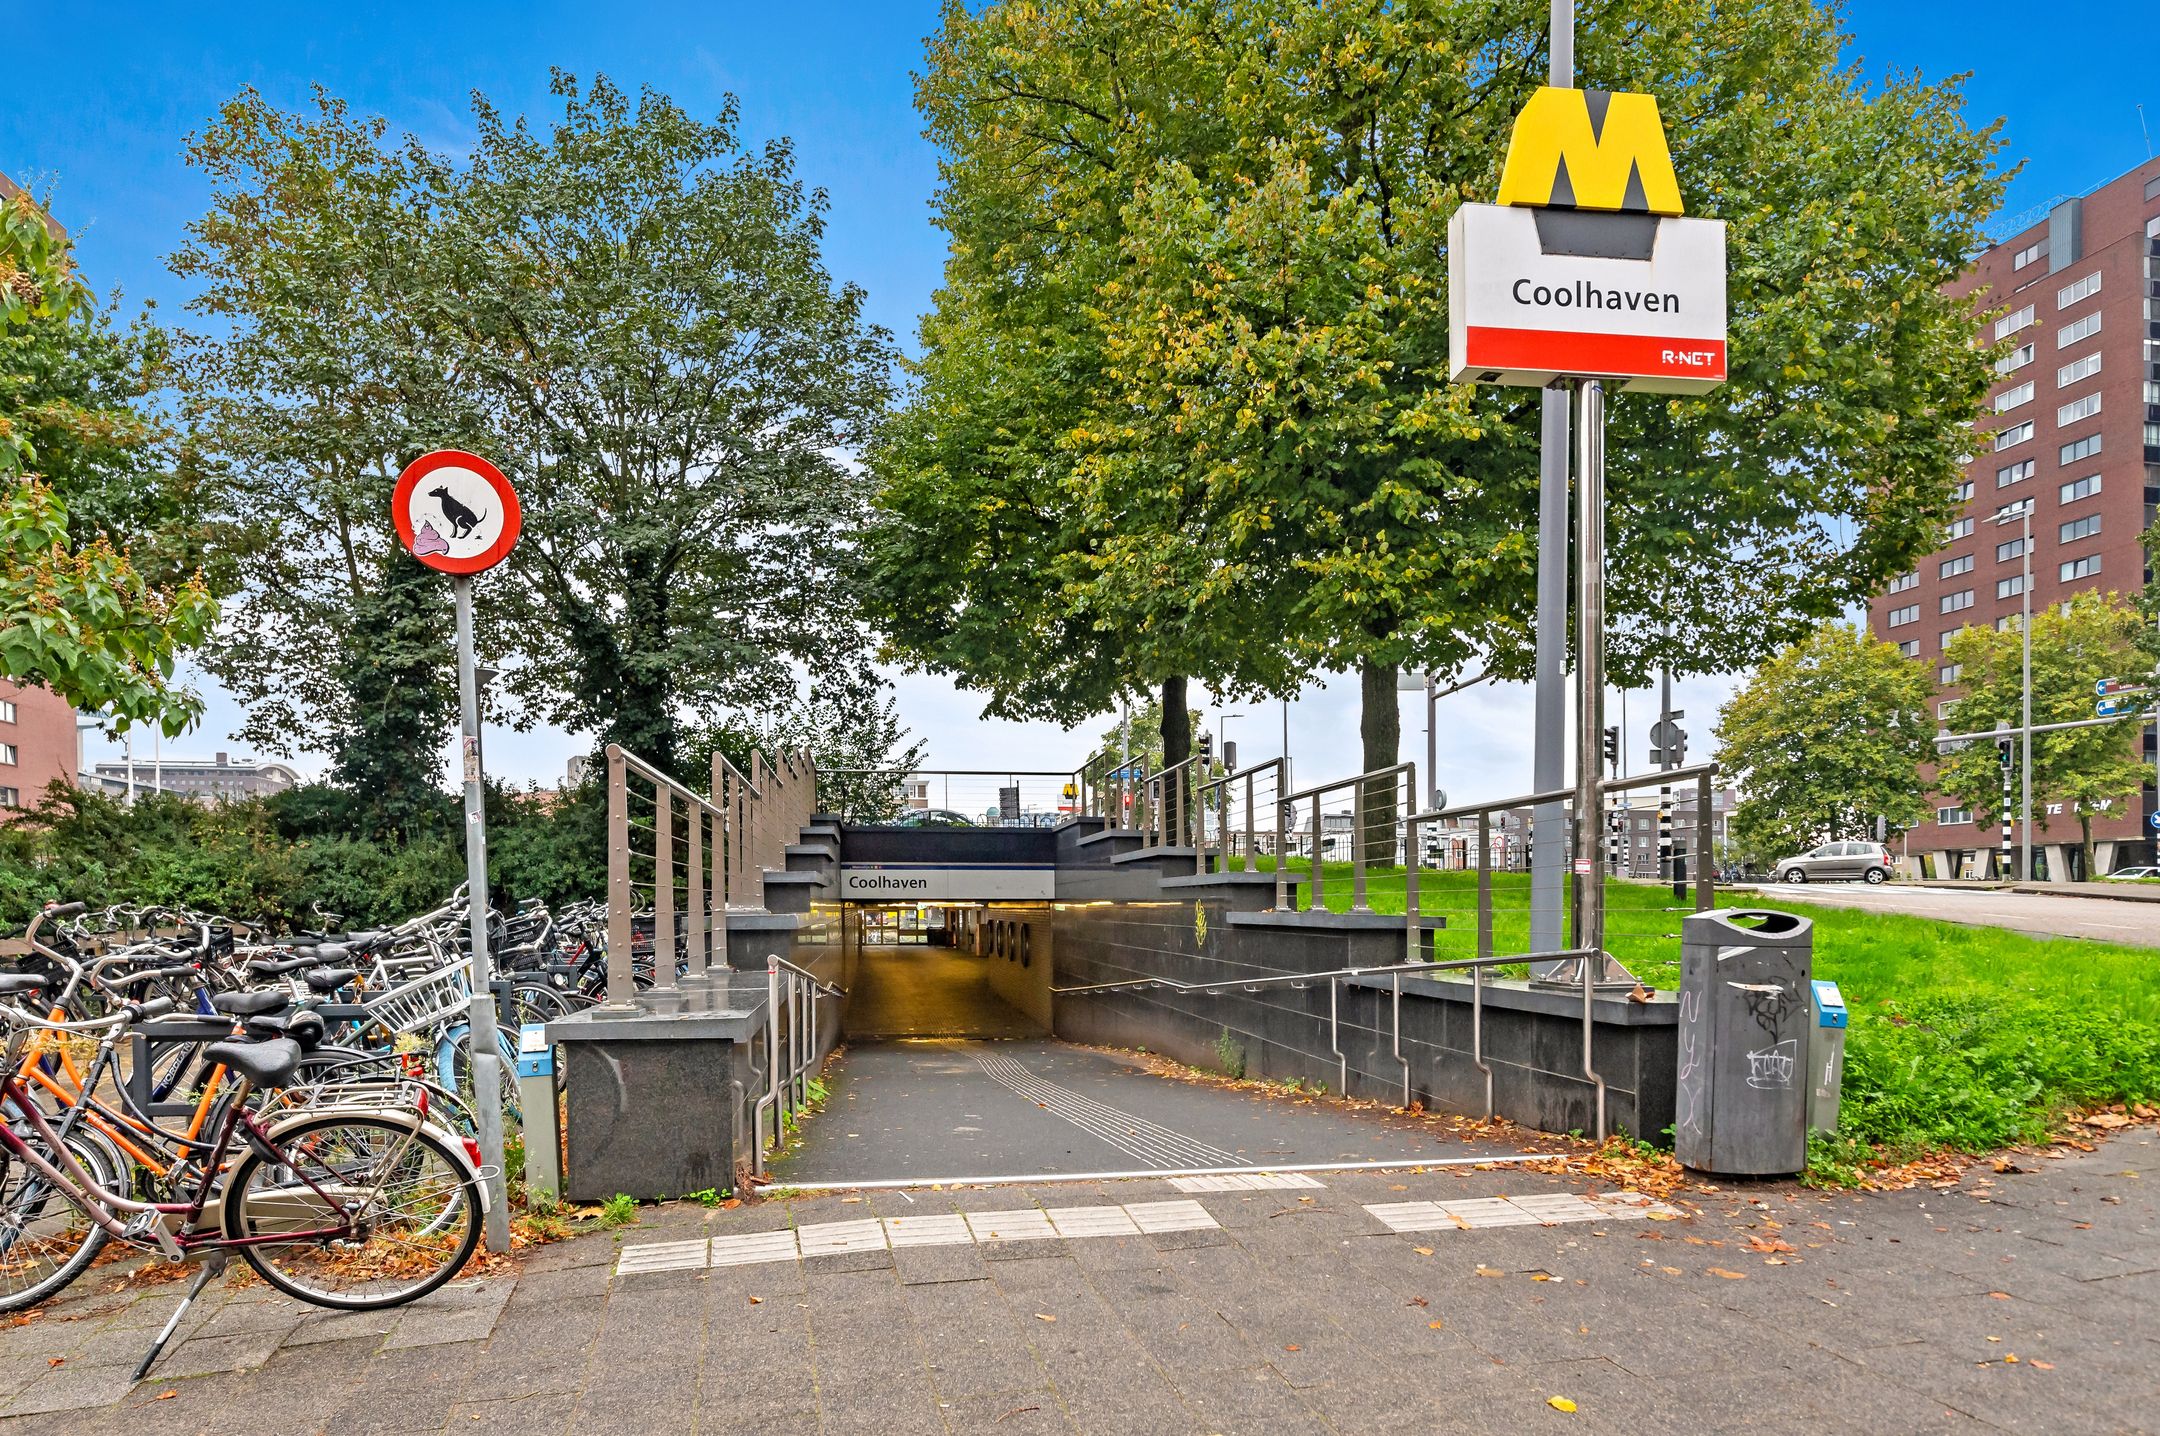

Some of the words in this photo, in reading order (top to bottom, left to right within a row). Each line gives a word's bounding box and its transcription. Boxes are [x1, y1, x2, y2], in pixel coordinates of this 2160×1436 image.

[1496, 87, 1684, 217] M
[1512, 279, 1679, 313] Coolhaven
[849, 876, 927, 889] Coolhaven
